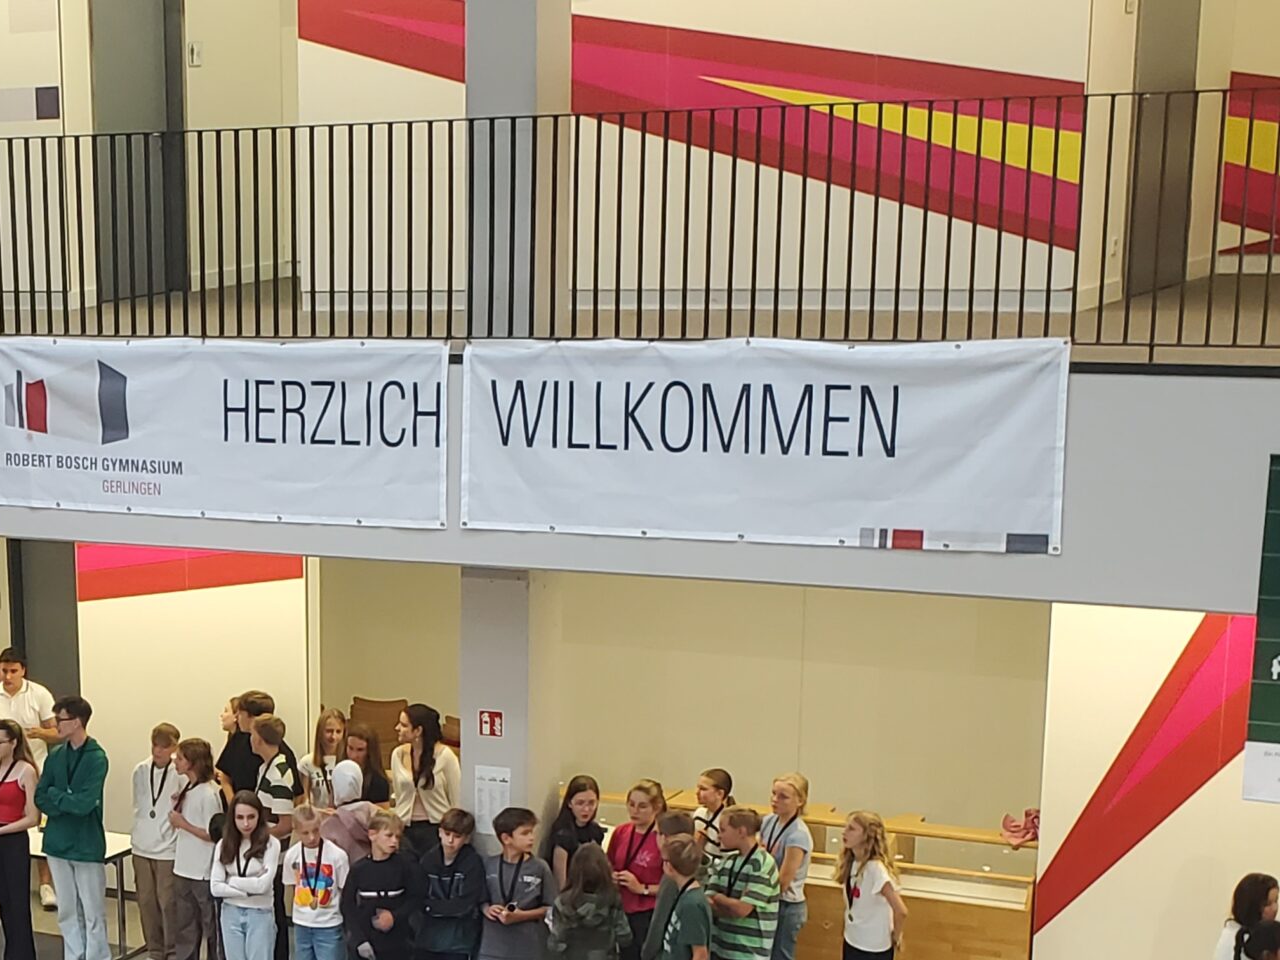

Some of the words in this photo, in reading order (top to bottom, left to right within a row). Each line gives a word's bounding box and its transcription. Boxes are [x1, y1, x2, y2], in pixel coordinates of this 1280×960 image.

[223, 378, 441, 448] HERZLICH
[490, 379, 900, 458] WILLKOMMEN
[5, 452, 52, 468] ROBERT
[56, 456, 98, 471] BOSCH
[102, 457, 183, 475] GYMNASIUM
[102, 479, 162, 496] GERLINGEN
